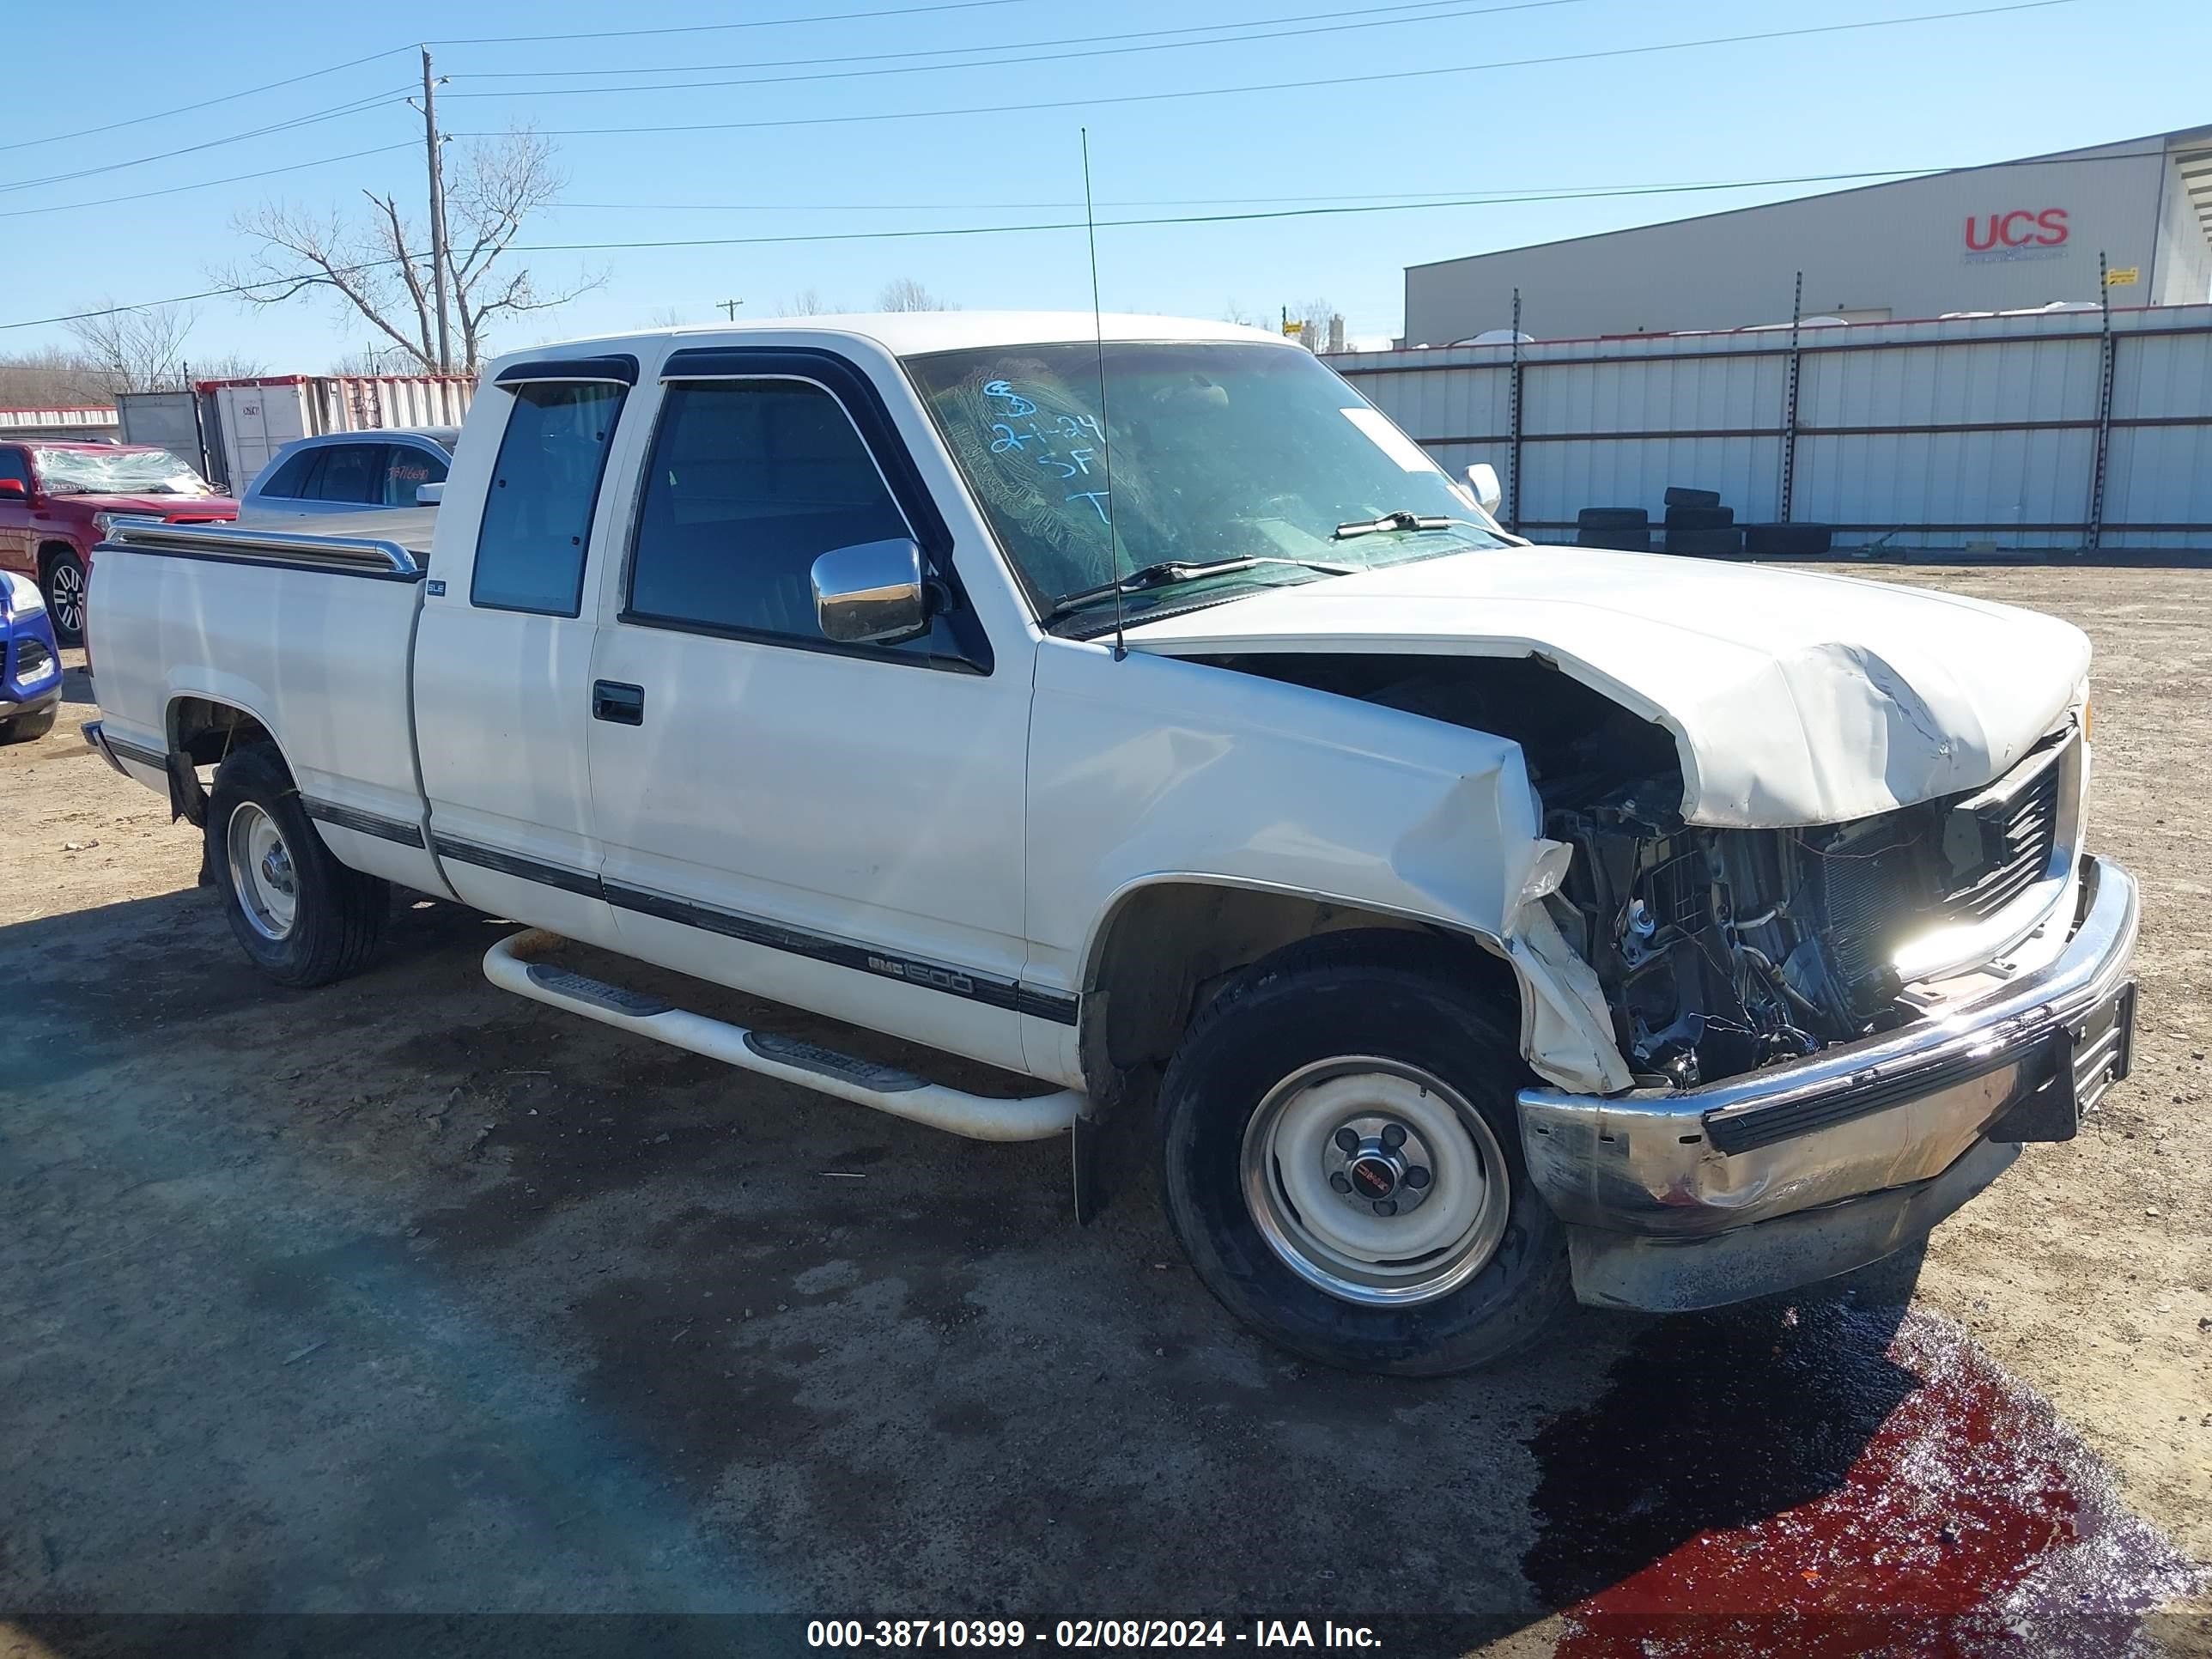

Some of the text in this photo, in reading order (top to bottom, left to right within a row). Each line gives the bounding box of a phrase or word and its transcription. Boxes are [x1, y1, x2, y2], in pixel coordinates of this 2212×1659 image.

[1966, 209, 2068, 250] UCS
[428, 584, 444, 592] SLE
[867, 956, 974, 994] GMC 1500
